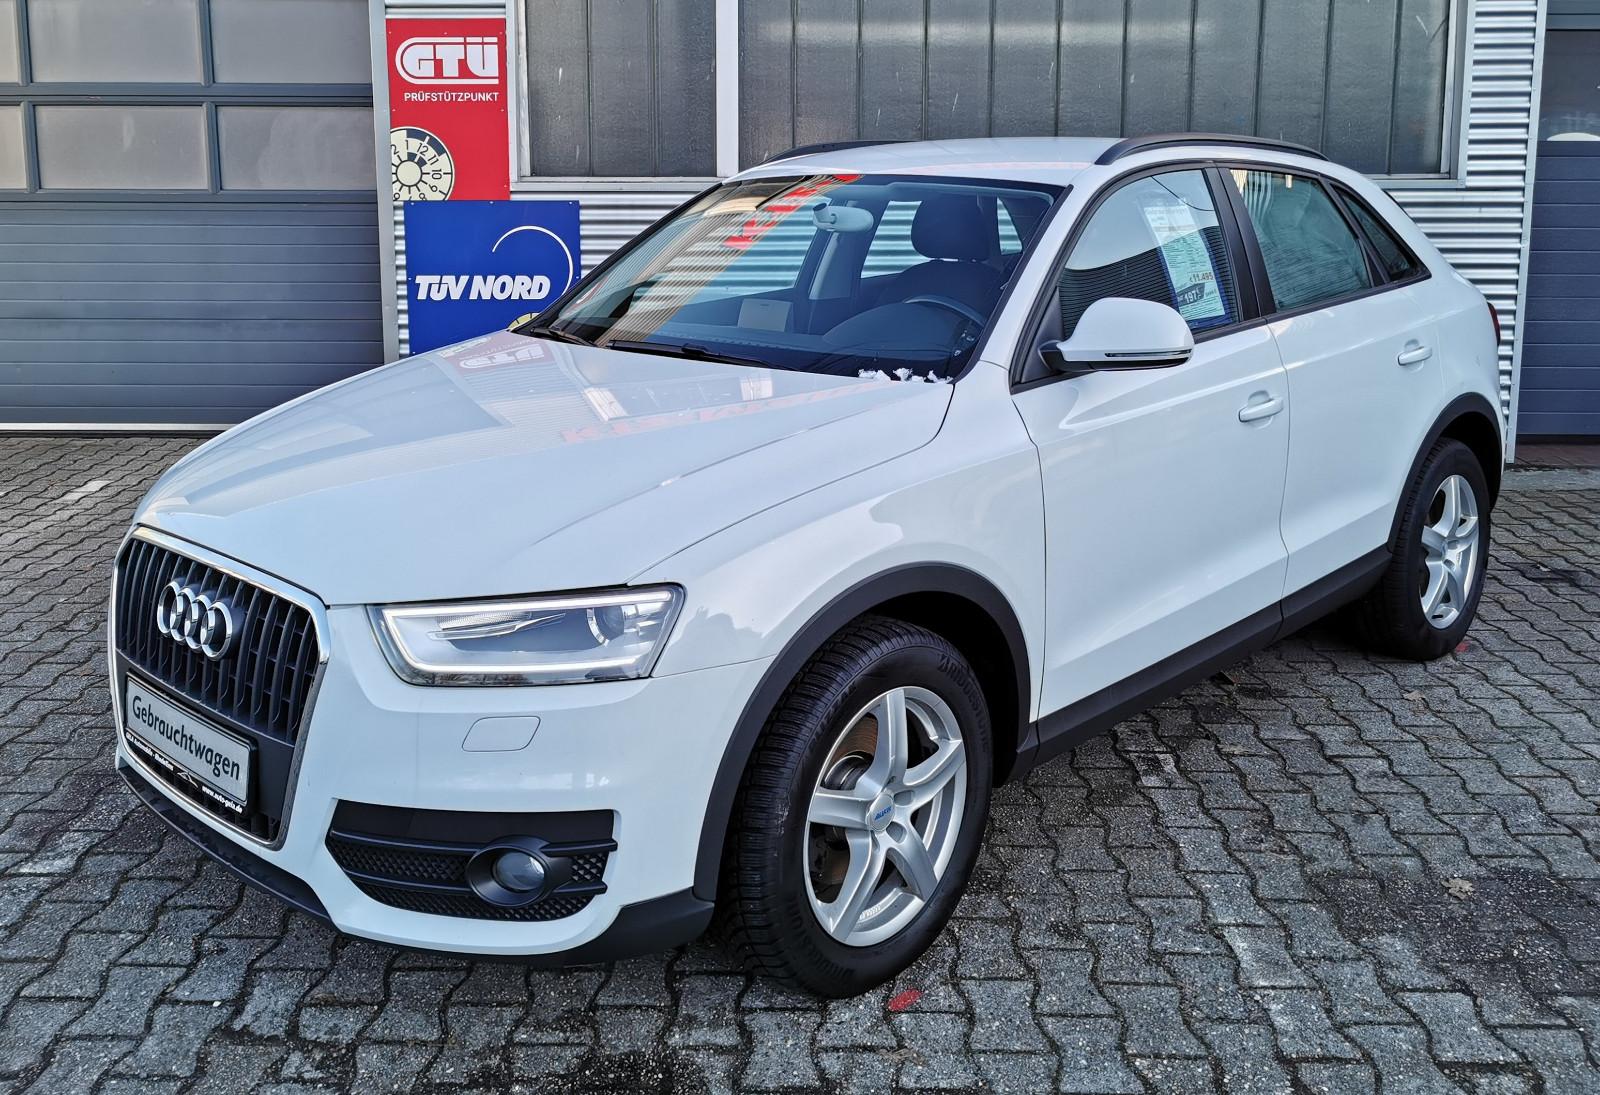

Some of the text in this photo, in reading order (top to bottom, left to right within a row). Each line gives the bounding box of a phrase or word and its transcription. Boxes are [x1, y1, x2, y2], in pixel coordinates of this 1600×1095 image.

[395, 36, 499, 85] GTÜ
[404, 91, 499, 103] PRÜFSTÜTZPUNKT
[416, 142, 429, 157] 12
[431, 168, 443, 180] 10
[415, 274, 551, 301] TÜV NORD
[131, 696, 240, 781] Gebrauchtwagen
